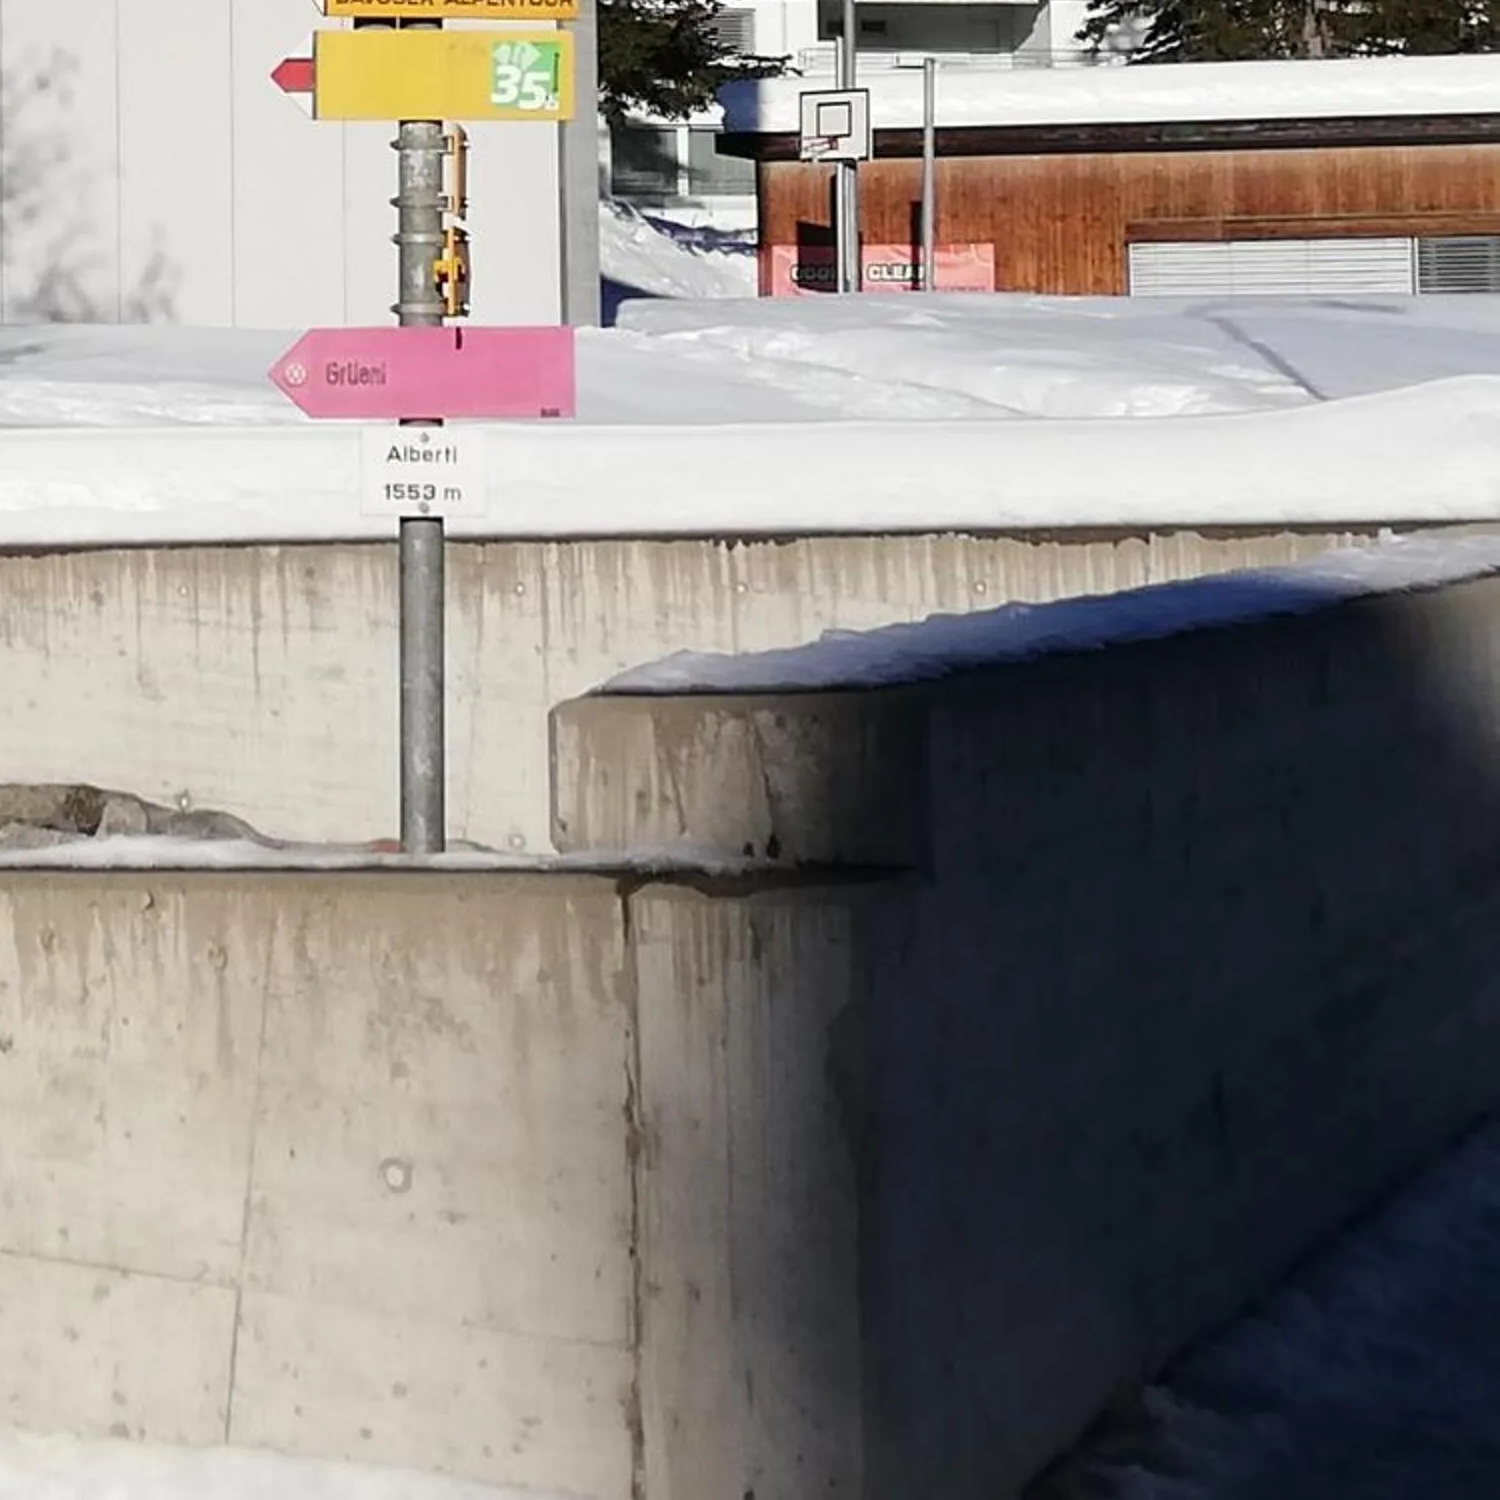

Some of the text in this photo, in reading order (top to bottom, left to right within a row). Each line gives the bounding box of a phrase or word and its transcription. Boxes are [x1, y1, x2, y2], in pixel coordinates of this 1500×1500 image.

[491, 65, 550, 109] 35
[386, 445, 458, 463] Alberti
[385, 484, 462, 501] 1553 m
